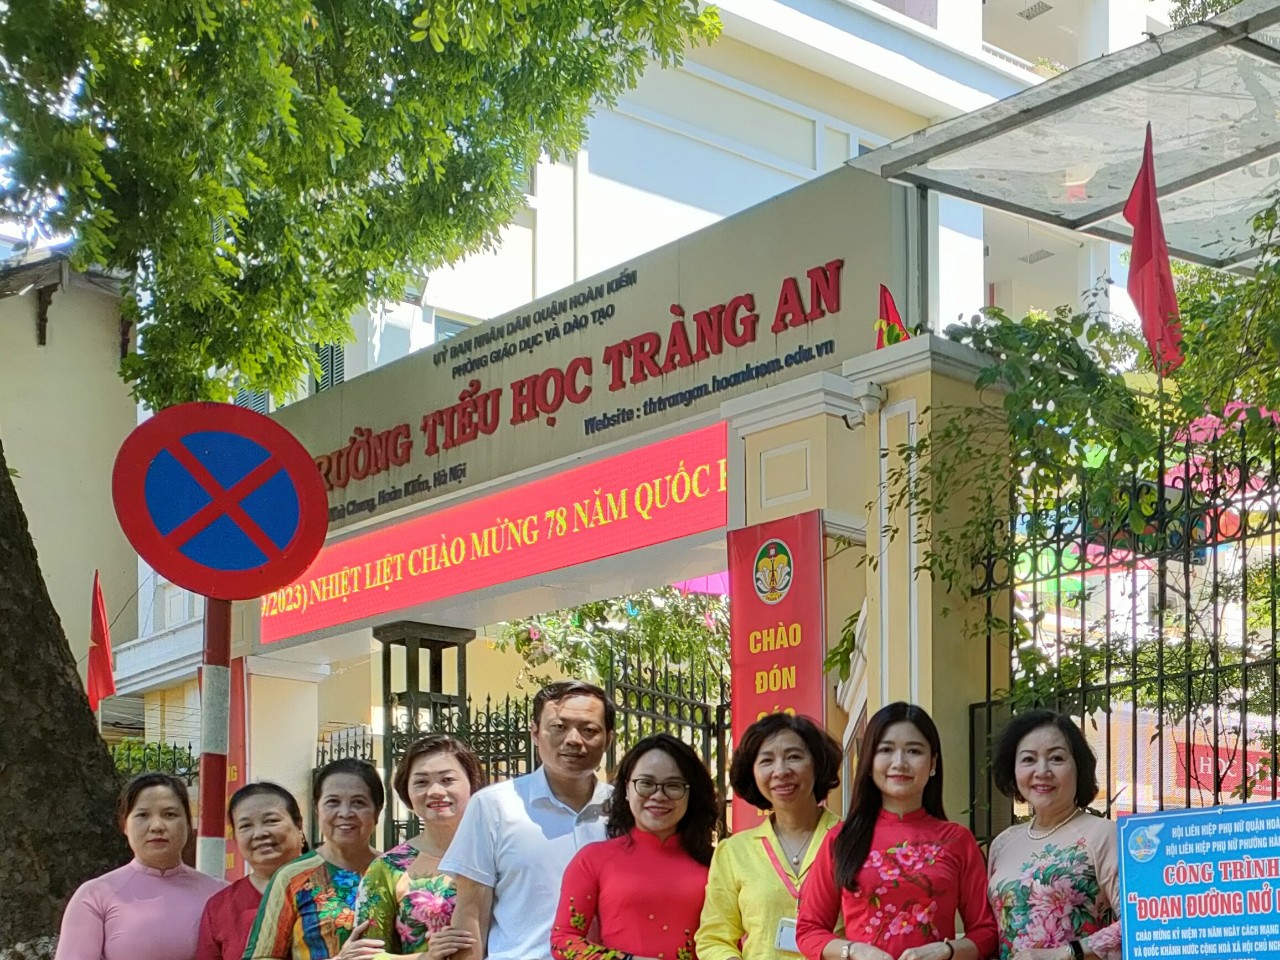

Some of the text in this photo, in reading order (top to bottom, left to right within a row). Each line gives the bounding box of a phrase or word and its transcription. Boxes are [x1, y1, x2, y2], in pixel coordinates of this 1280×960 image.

[450, 339, 473, 359] BAN
[474, 326, 505, 350] NHÂN
[506, 315, 531, 336] DÂN
[533, 301, 567, 324] QUẬN
[569, 284, 605, 310] HOÀN
[607, 267, 638, 295] KIẾM
[452, 355, 488, 380] PHÒNG
[490, 342, 518, 363] GIÁO
[519, 333, 543, 354] DỤC
[545, 322, 561, 343] VÀ
[590, 304, 616, 325] TẠO
[314, 258, 845, 491] RƯỜNG TIỂU HỌC TRÀNG AN
[584, 408, 635, 436] Website
[378, 486, 402, 506] Hoàn
[433, 469, 448, 488] Hà
[449, 462, 467, 484] Nội
[309, 565, 362, 605] NHIỆT
[365, 553, 405, 592] LIỆT
[407, 533, 466, 577] CHÀO
[470, 515, 539, 561] MỪNG
[544, 506, 568, 540] 78
[573, 486, 629, 533] NĂM
[634, 460, 711, 521] QUỐC
[749, 621, 802, 654] CHÀO
[755, 663, 797, 694] ĐÓN
[1172, 825, 1184, 840] HỘI
[1185, 823, 1200, 837] LIÊN
[1201, 822, 1217, 837] HIỆP
[1218, 822, 1232, 836] PHỤ
[1234, 819, 1245, 833] NỮ
[1245, 818, 1265, 833] QUẬN
[1166, 843, 1178, 858] HỘI
[1179, 841, 1194, 855] LIÊN
[1195, 840, 1211, 855] HIỆP
[1212, 840, 1226, 854] PHỤ
[1227, 838, 1238, 851] NỮ
[1239, 835, 1268, 850] PHƯỜNG
[1164, 856, 1280, 885] CÔNG TRÌNH
[1186, 888, 1243, 918] ĐƯỜNG
[1247, 882, 1272, 914] NỞ
[1133, 945, 1142, 957] VÀ
[1143, 943, 1159, 958] QUỐC
[1160, 944, 1181, 956] KHÁNH
[1182, 942, 1199, 955] NƯỚC
[1200, 942, 1217, 956] CỘNG
[1232, 940, 1241, 953] XÃ
[1242, 940, 1253, 954] HỘI
[1254, 937, 1268, 951] CHỦ
[1135, 929, 1152, 941] CHÀO
[1153, 928, 1171, 941] MỪNG
[1181, 927, 1198, 941] NIỆM
[1198, 927, 1206, 939] 78
[1207, 925, 1222, 938] NĂM
[1223, 924, 1240, 937] NGÀY
[1241, 923, 1258, 936] CÁCH
[1260, 923, 1279, 937] MẠNG
